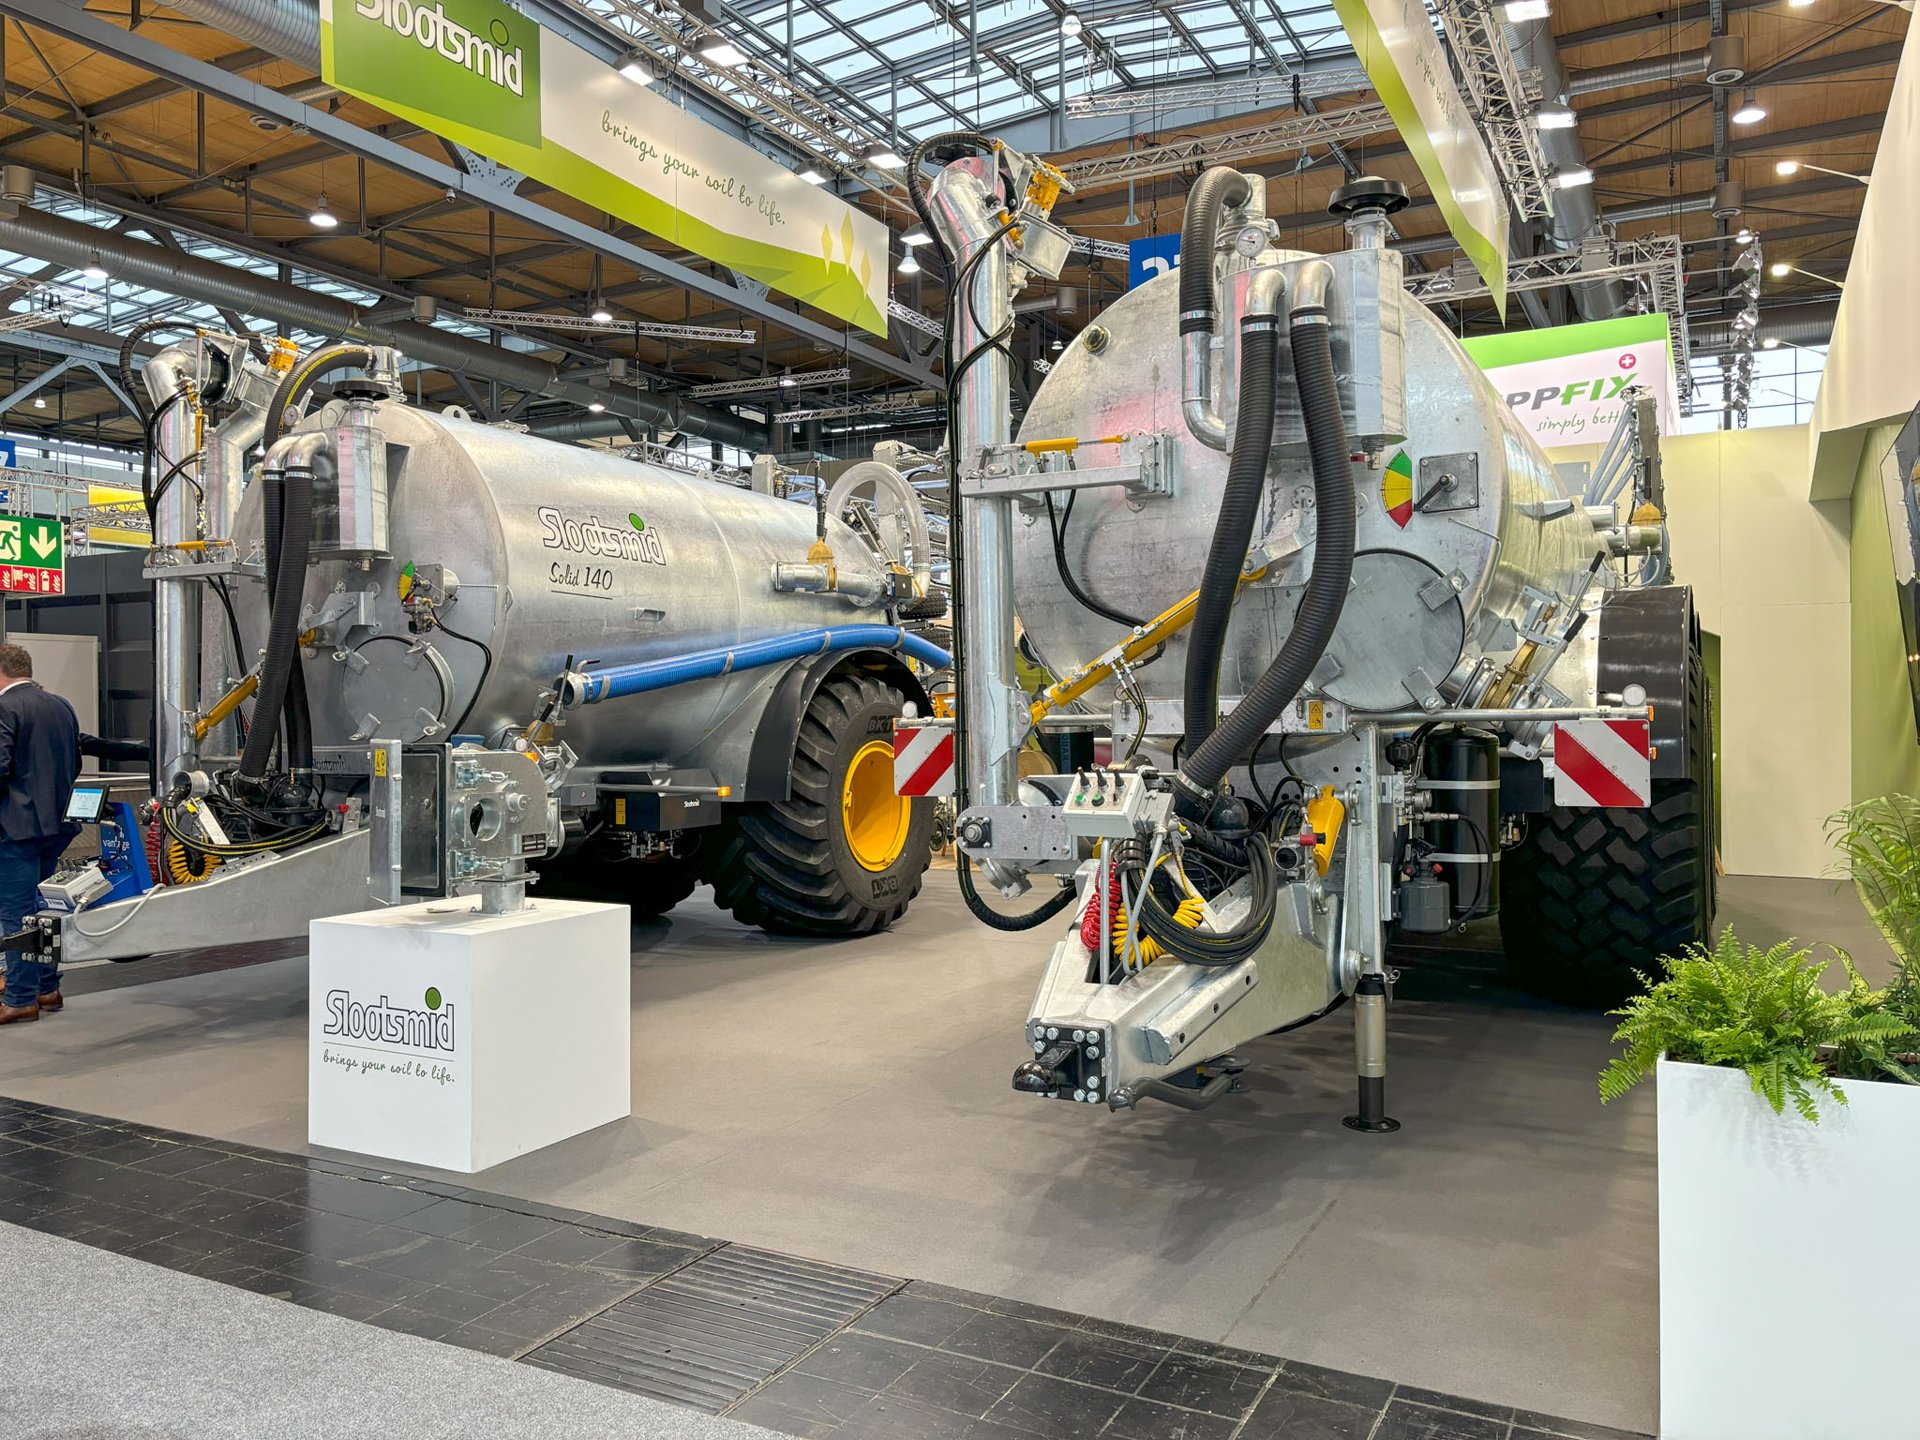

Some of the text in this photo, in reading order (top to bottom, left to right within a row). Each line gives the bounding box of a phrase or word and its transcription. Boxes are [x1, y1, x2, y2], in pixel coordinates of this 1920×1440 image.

[601, 109, 786, 226] brings your soil to life.
[1500, 372, 1639, 410] PPFIX
[1536, 406, 1621, 436] simply bett
[537, 506, 666, 566] Slootsmid
[549, 562, 613, 590] Solid 140
[323, 986, 455, 1052] Slootsmid
[323, 1049, 455, 1086] brings your soil to life.
